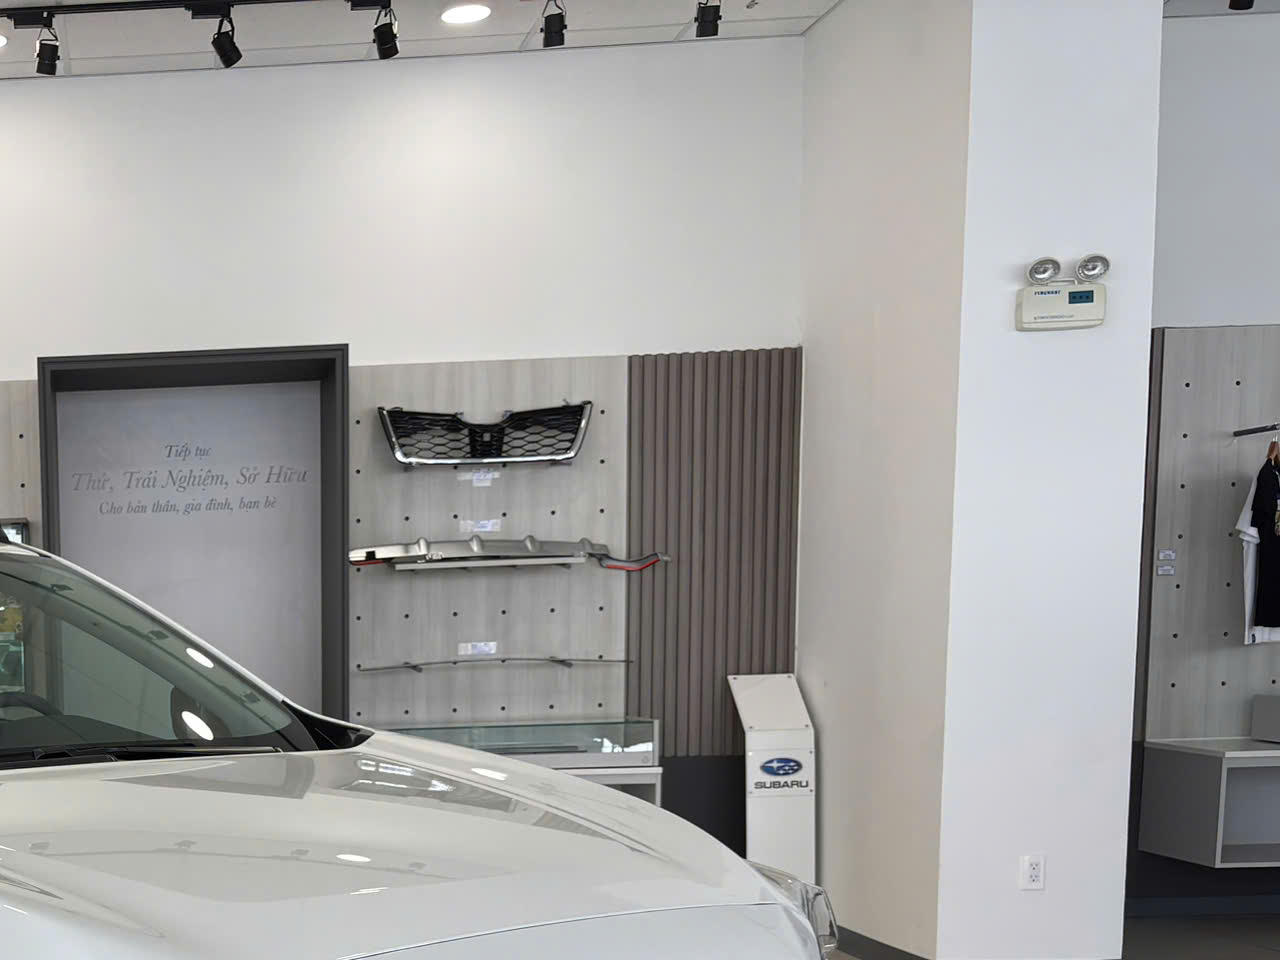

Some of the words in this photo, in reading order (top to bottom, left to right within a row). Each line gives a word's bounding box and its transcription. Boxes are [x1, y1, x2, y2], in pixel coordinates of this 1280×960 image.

[165, 442, 192, 461] Tiếp
[195, 446, 213, 461] tục
[161, 469, 229, 493] Nghiệm,
[99, 500, 124, 515] Cho
[182, 499, 202, 516] gia
[205, 498, 234, 513] đình,
[238, 497, 260, 513] bạn
[263, 496, 278, 510] bè
[754, 780, 809, 789] SUBARU
